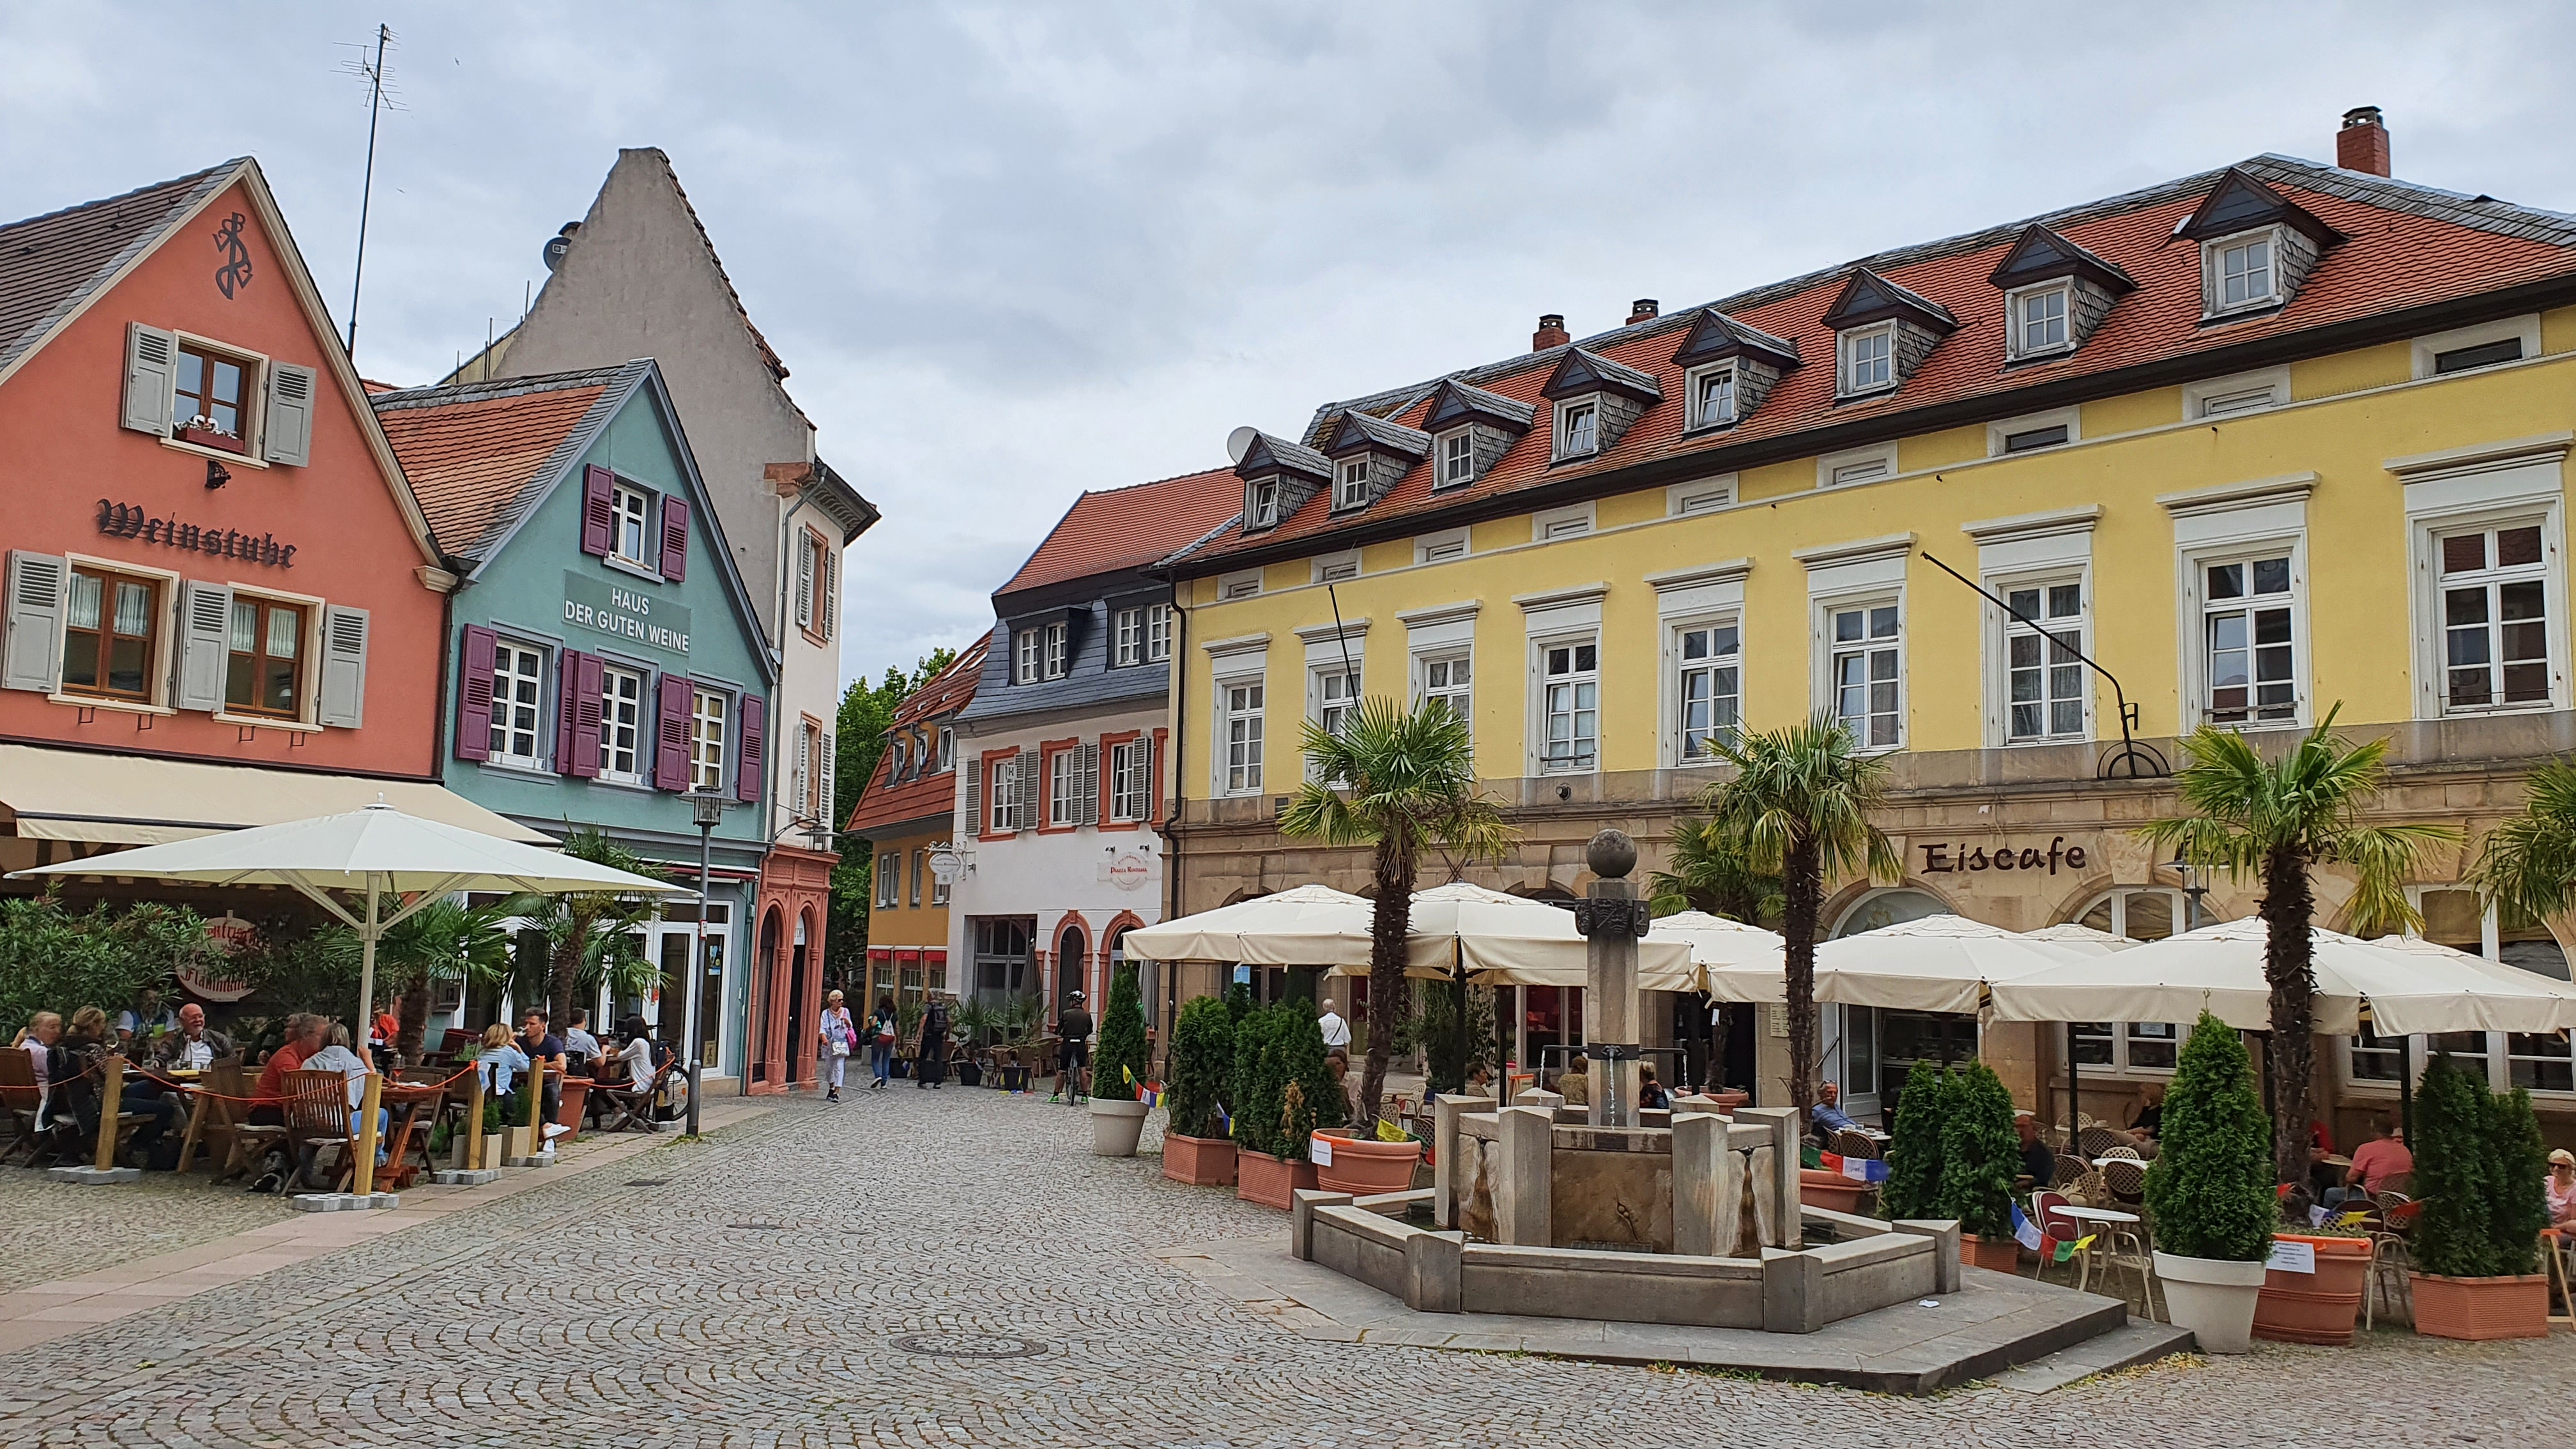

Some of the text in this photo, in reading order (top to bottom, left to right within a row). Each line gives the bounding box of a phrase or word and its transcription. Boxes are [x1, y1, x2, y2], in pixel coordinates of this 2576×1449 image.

[97, 498, 297, 568] Weinstube
[611, 588, 650, 615] HAUS
[565, 600, 689, 652] DER GUTEN WEINE
[1917, 836, 2087, 875] Eiscafe
